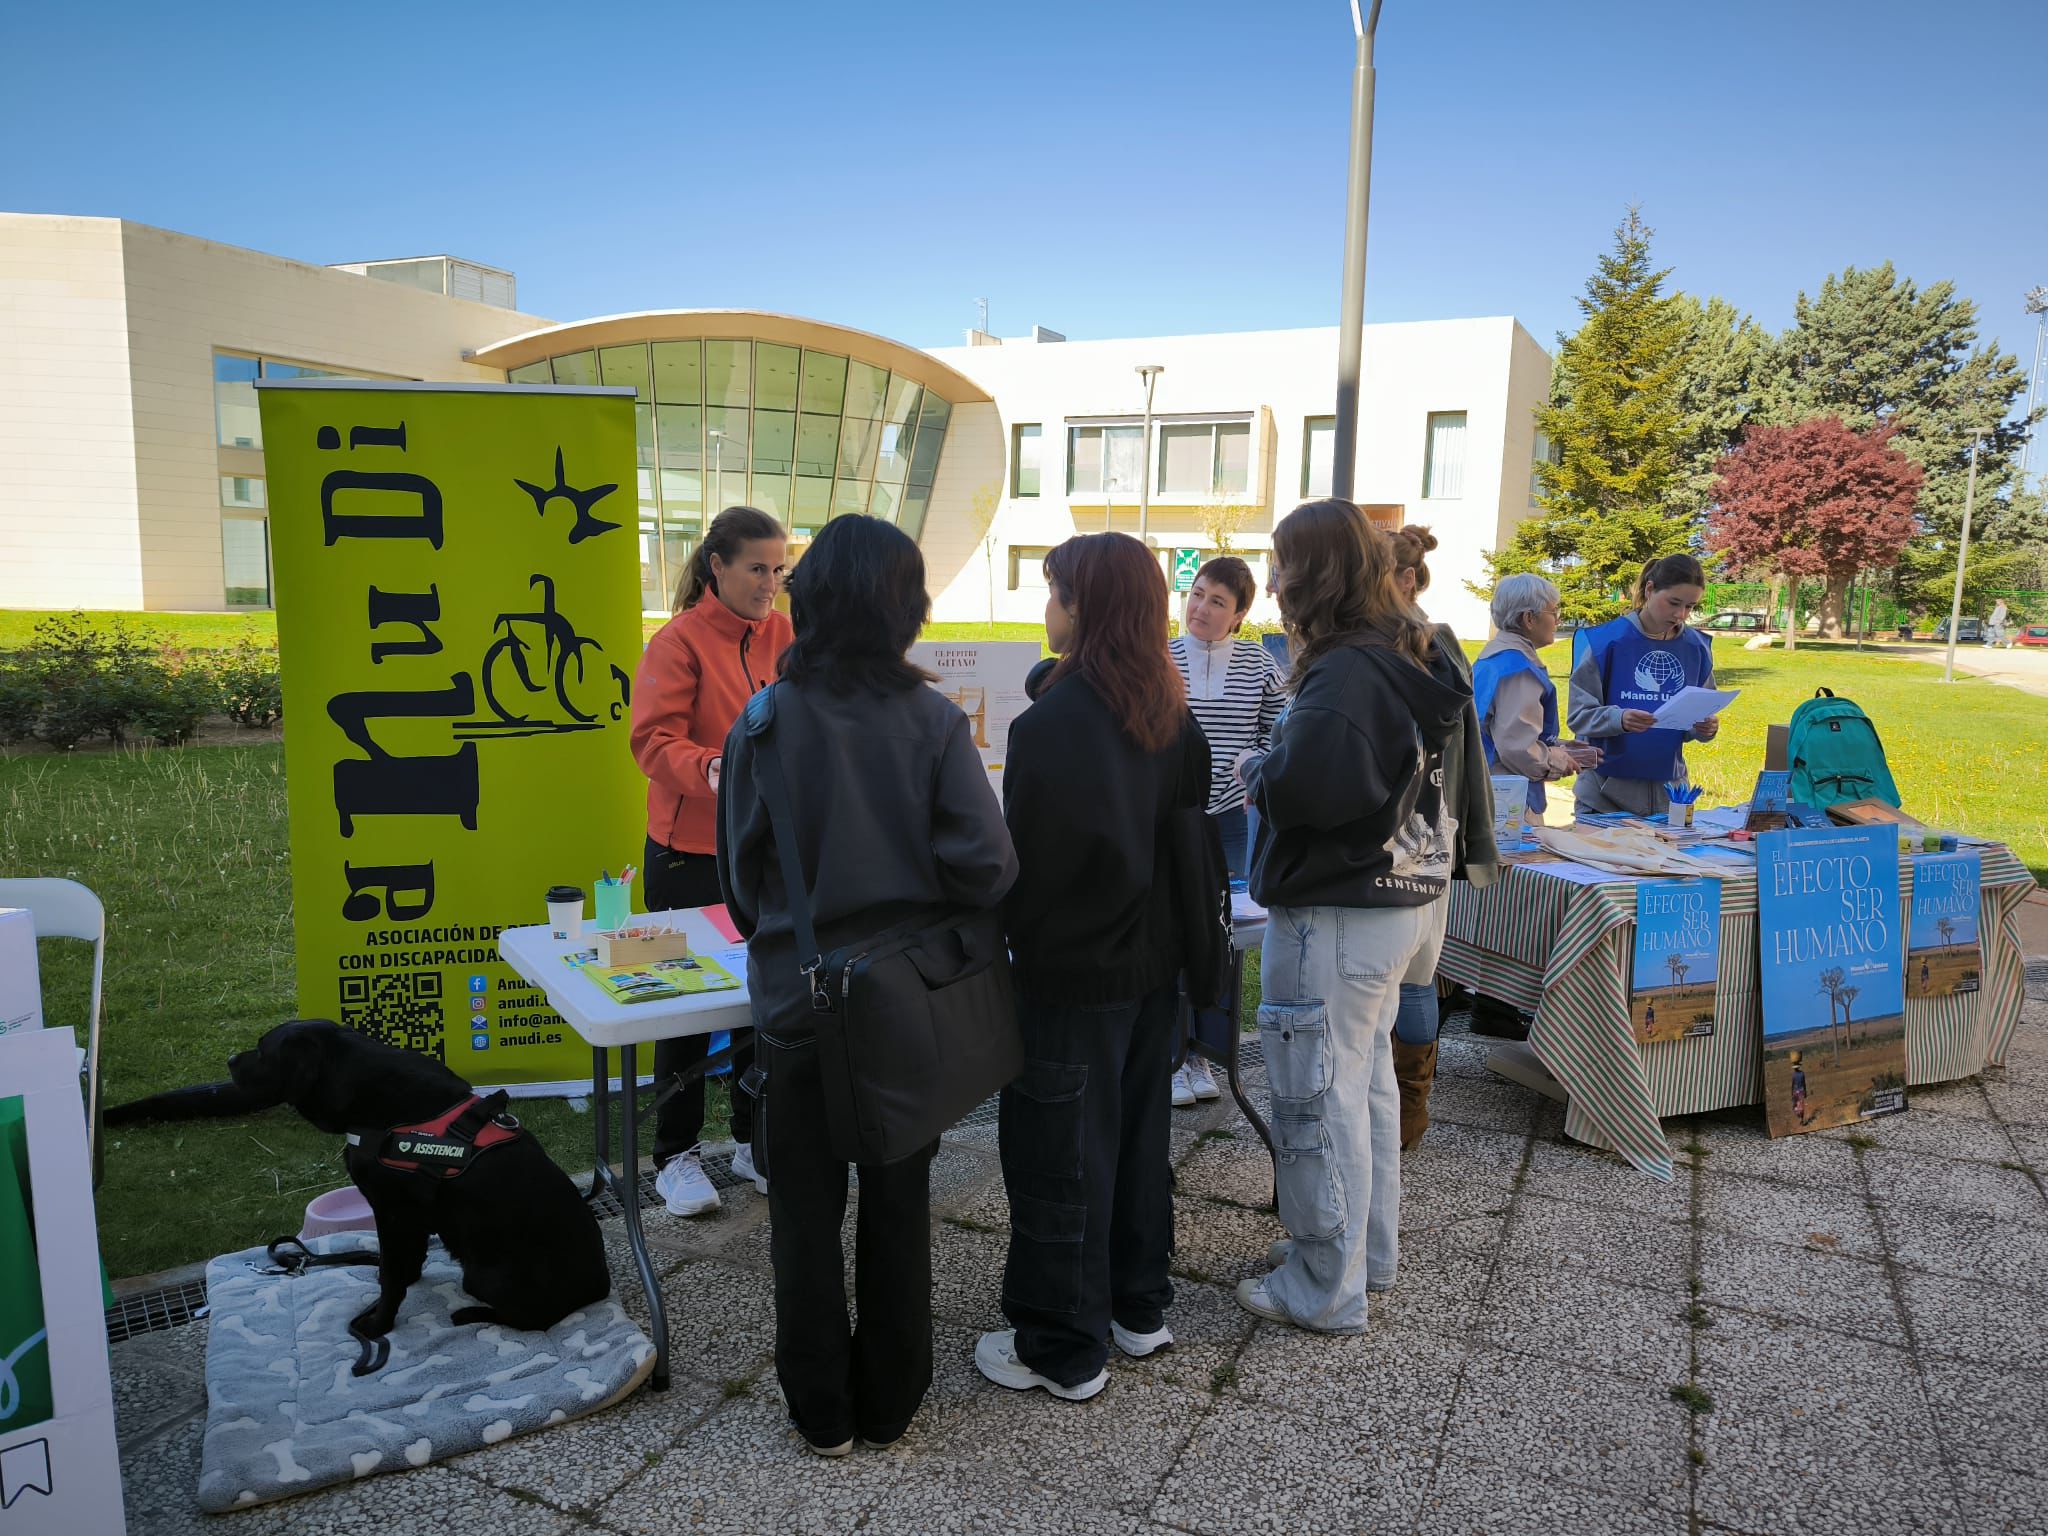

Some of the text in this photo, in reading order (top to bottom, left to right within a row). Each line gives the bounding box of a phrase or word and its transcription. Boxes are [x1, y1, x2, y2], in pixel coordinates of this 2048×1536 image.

[937, 659, 976, 667] GITANO
[1620, 690, 1658, 701] Manos
[1772, 849, 1782, 862] EL
[1773, 855, 1871, 896] EFECTO
[1920, 862, 1969, 883] EFECTO
[1952, 879, 1975, 897] SER
[1644, 892, 1703, 915] EFECTO
[1841, 887, 1885, 923] SER
[1918, 895, 1974, 915] HUMANO
[1682, 910, 1710, 930] SER
[366, 923, 475, 946] ASOCIACIÓN
[479, 925, 502, 941] DE
[1642, 927, 1711, 952] HUMANO
[1775, 919, 1887, 965] HUMANO
[338, 948, 506, 970] CON DISCAPACIDA
[500, 1032, 562, 1047] anudi.es
[412, 1142, 465, 1158] ASISTENCIA
